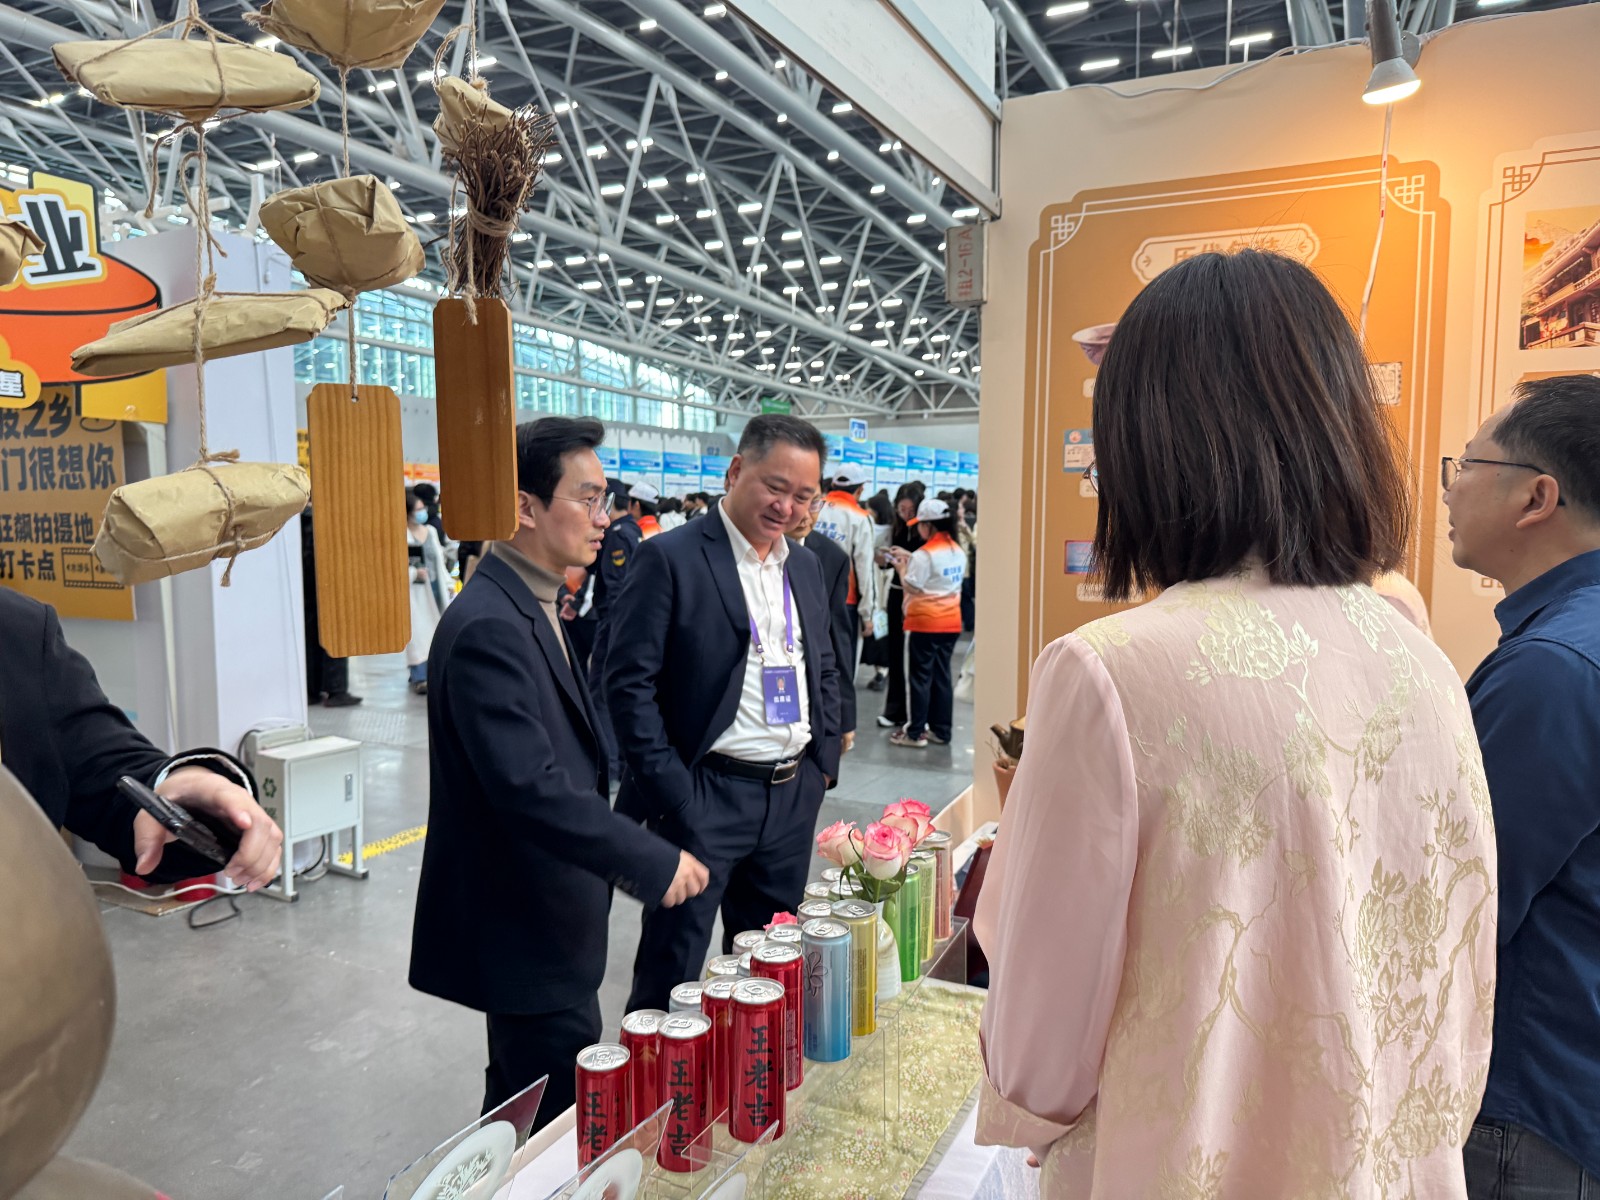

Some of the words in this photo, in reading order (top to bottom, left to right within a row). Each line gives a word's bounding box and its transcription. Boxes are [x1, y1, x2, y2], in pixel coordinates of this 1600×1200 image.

[1, 442, 116, 492] 门很想你
[0, 549, 56, 581] 打卡点
[667, 1059, 695, 1156] 王老吉
[744, 1025, 774, 1127] 王老吉
[583, 1091, 608, 1167] 王老
